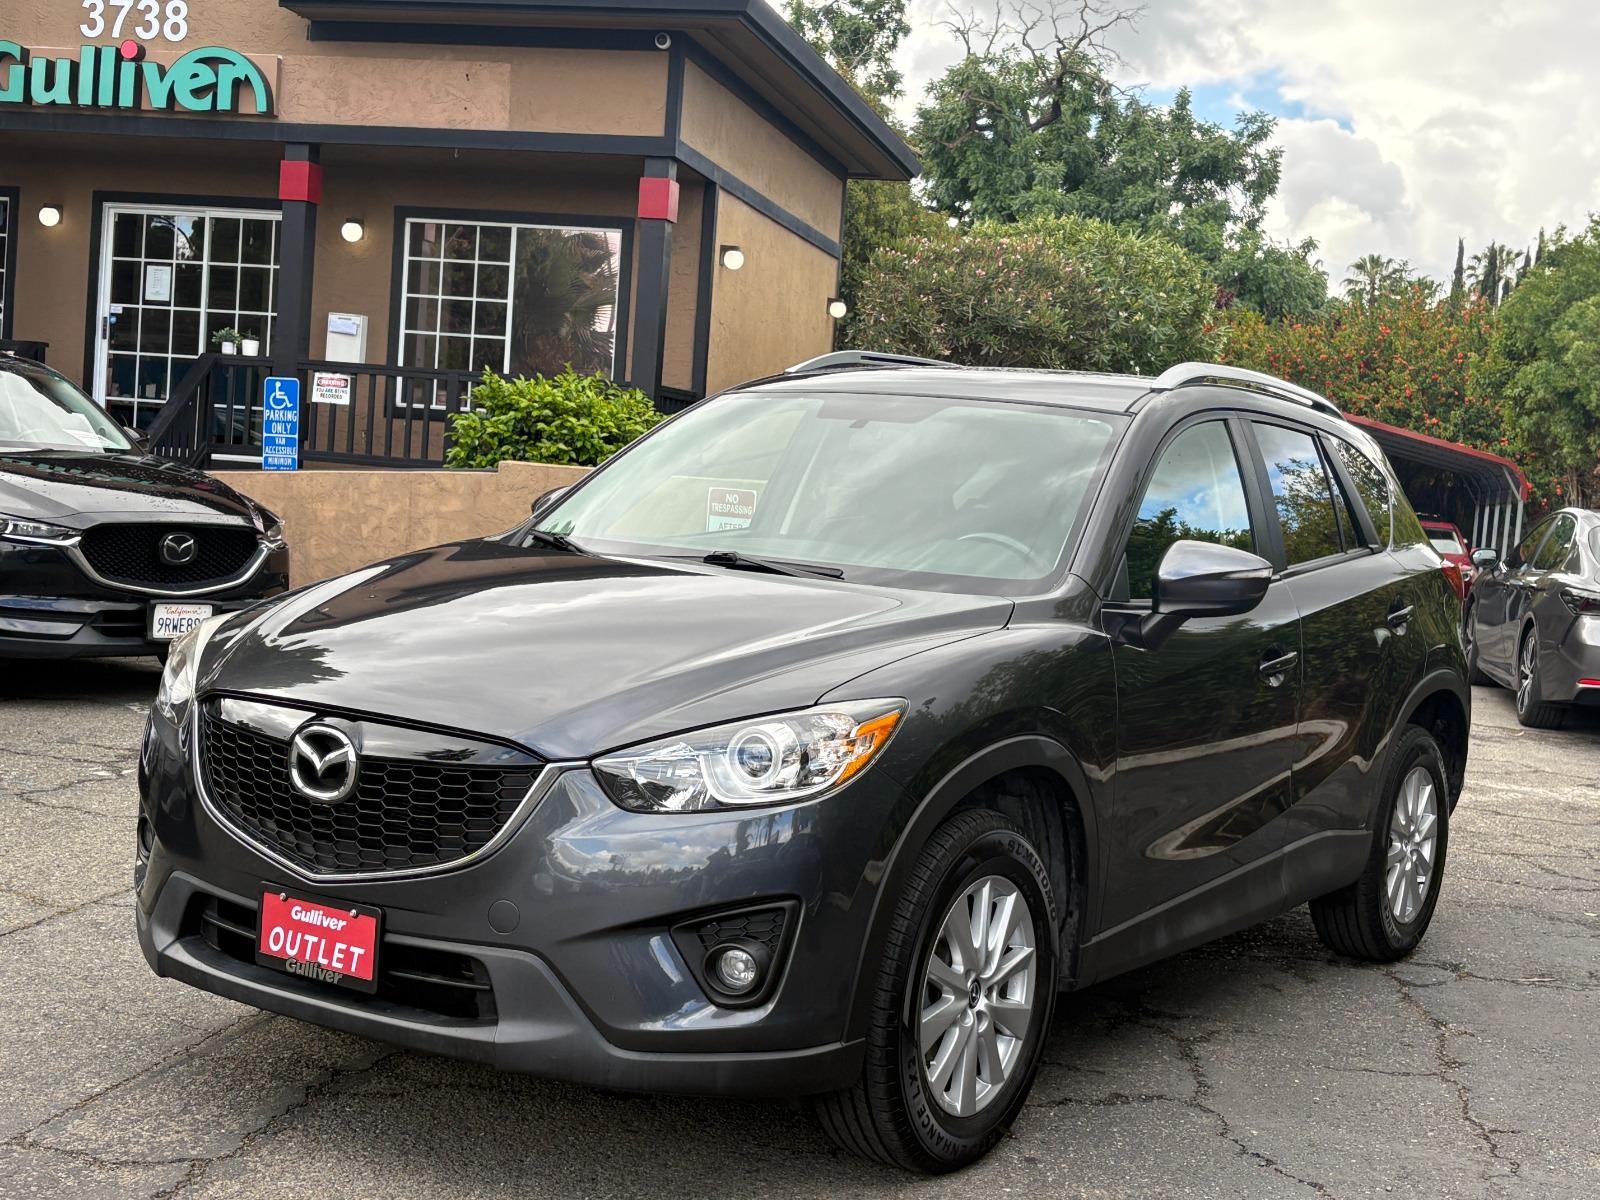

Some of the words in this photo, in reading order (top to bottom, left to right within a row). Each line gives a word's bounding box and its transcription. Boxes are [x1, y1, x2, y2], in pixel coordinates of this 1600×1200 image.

[80, 0, 188, 42] 3738
[265, 409, 297, 422] PARKING
[271, 422, 292, 434] ONLY
[275, 437, 286, 445] VAN
[265, 446, 296, 455] ACCESSIBLE
[267, 457, 292, 466] MINIMUM
[725, 493, 739, 504] NO
[711, 502, 753, 515] TRESPASSING
[718, 522, 743, 531] AFTER
[1007, 839, 1057, 922] SUMITOMO
[290, 905, 348, 931] Gulliver
[268, 926, 366, 973] OUTLET
[285, 957, 343, 985] Gulliver
[916, 1103, 968, 1158] ENHANCE
